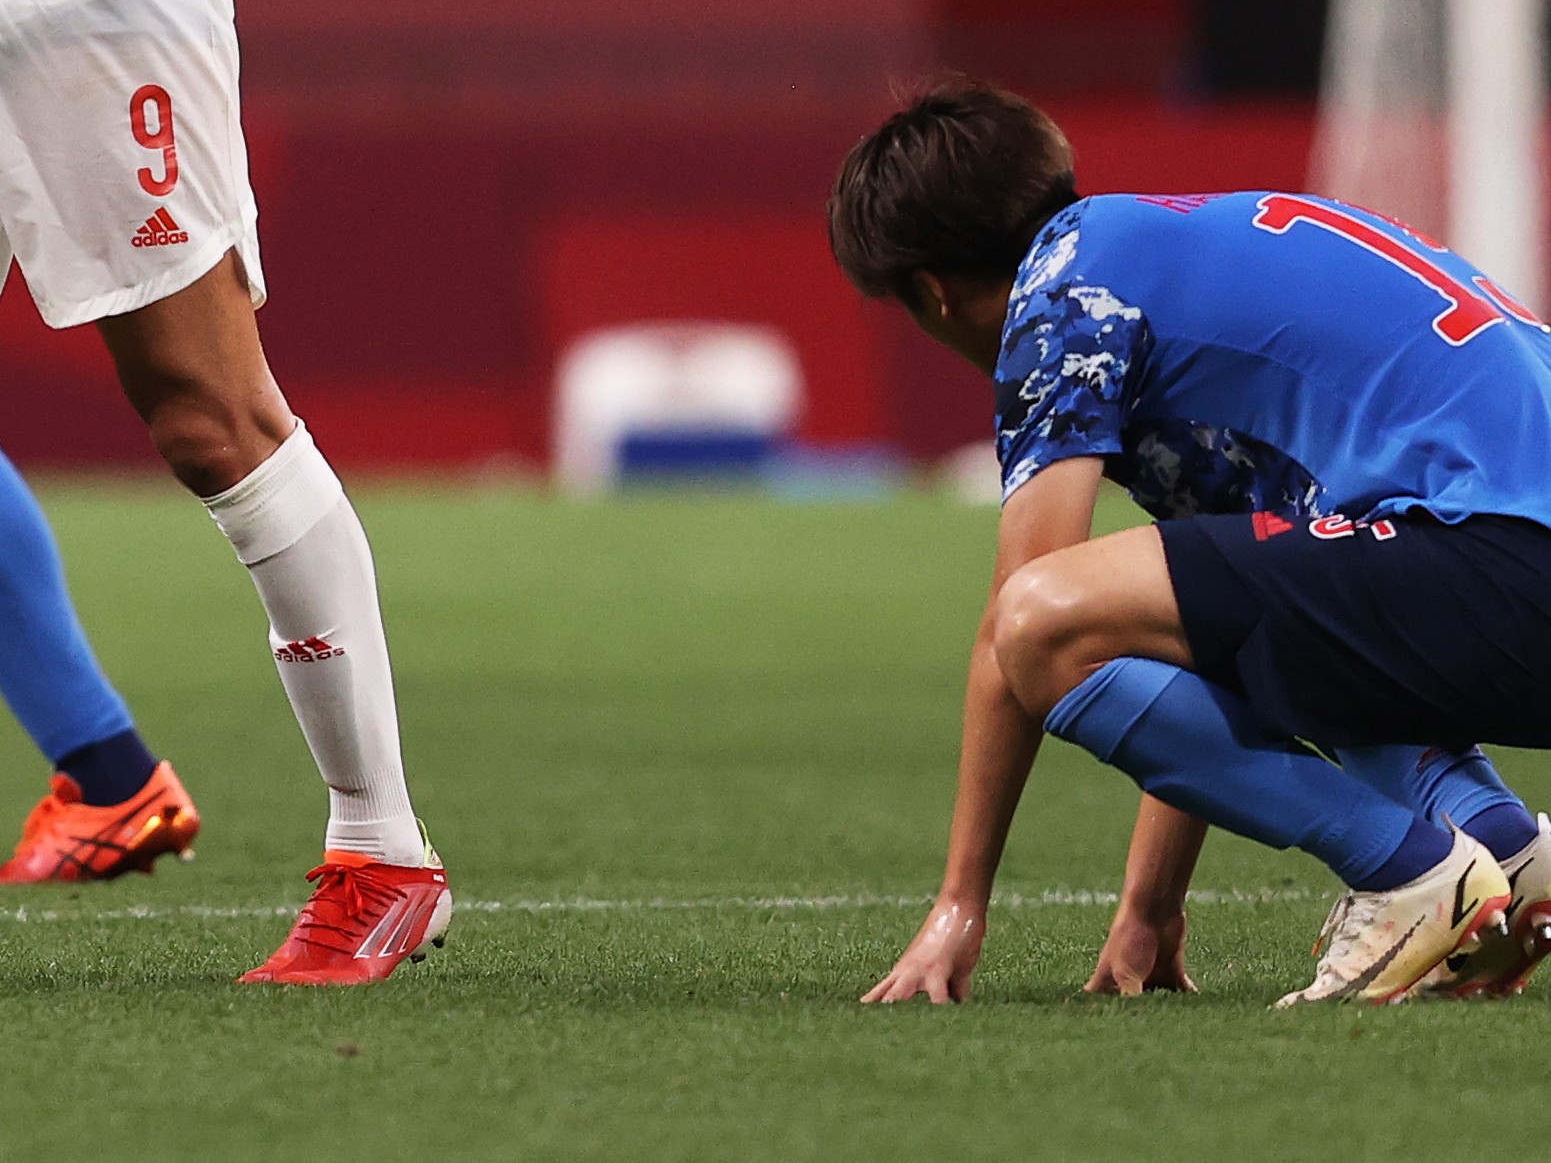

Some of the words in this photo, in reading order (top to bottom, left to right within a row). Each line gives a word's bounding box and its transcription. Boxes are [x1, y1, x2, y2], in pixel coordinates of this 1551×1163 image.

[129, 84, 179, 197] 9
[131, 230, 189, 248] adidas
[274, 647, 345, 663] adidas
